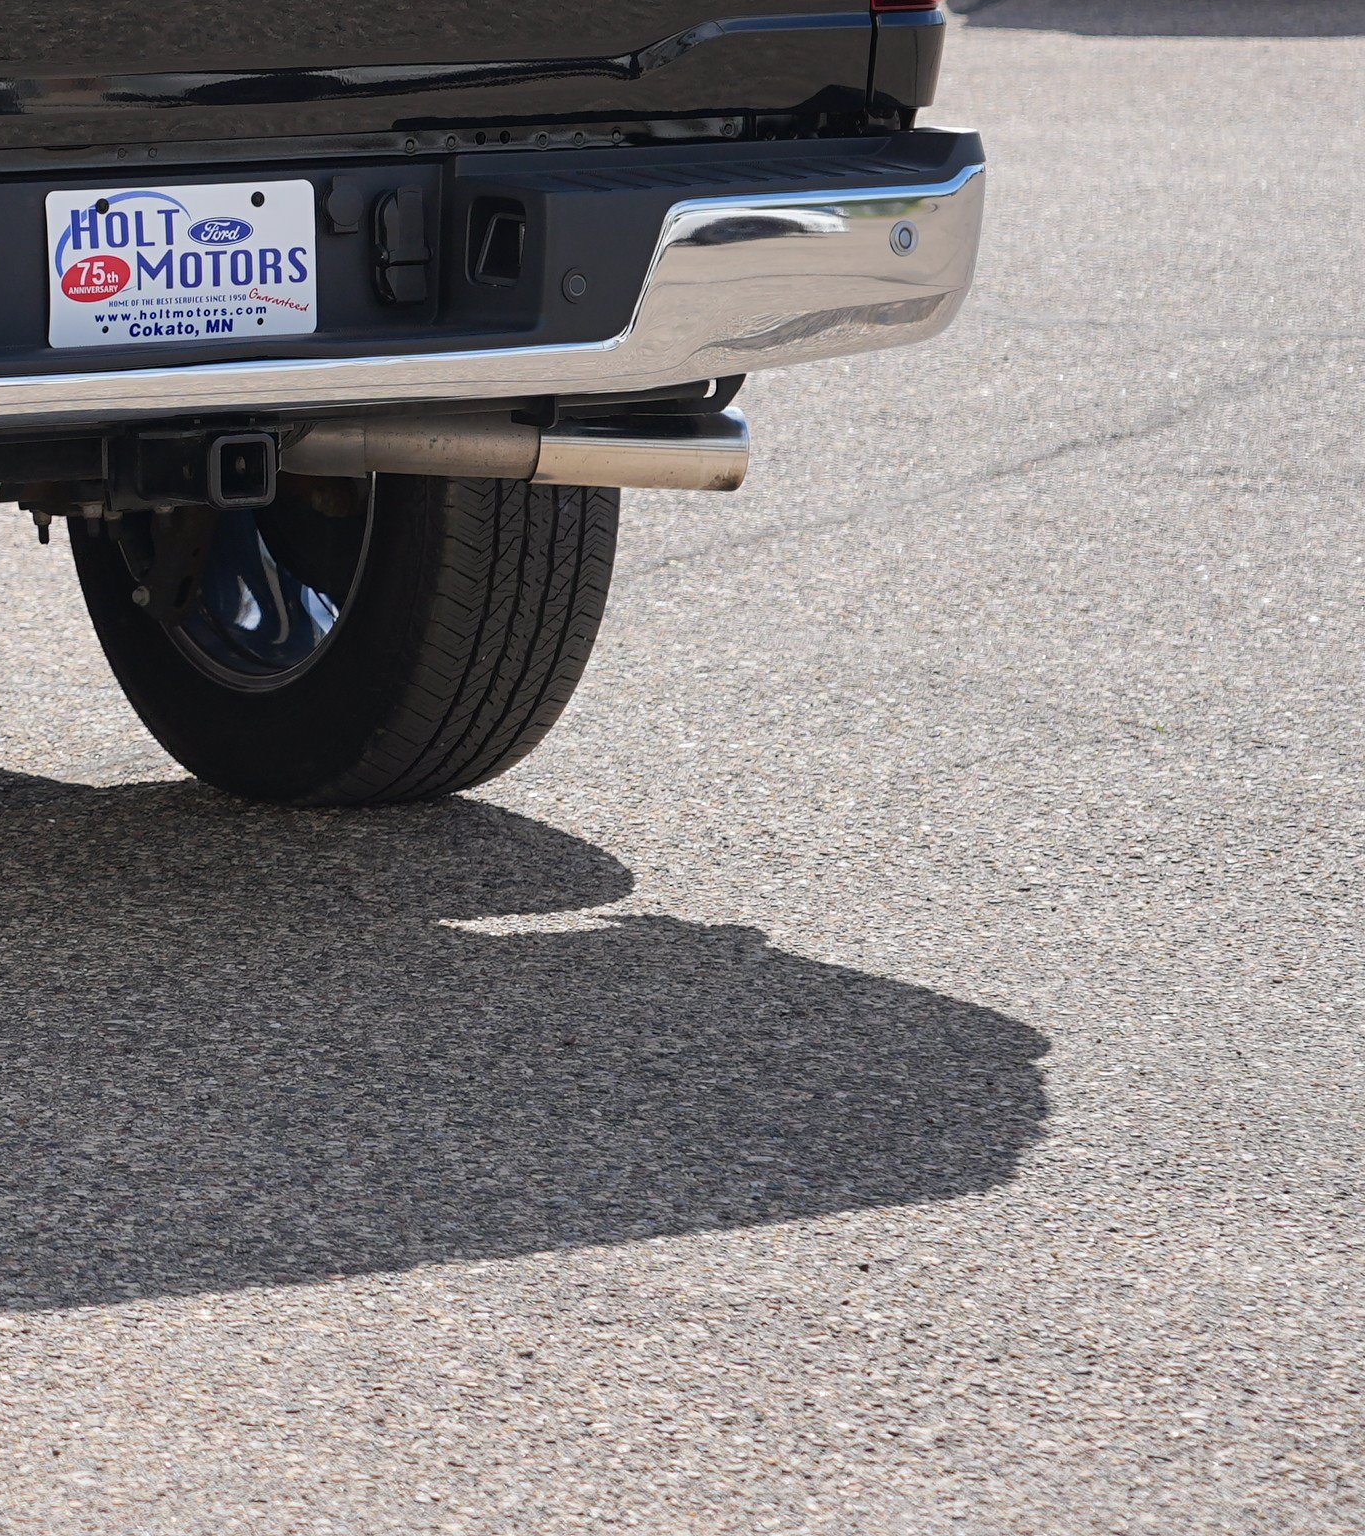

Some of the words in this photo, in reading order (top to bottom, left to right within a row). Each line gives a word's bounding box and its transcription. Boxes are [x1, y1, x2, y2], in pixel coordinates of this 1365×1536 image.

[71, 208, 180, 250] HOLT
[200, 221, 241, 242] Ford
[76, 261, 119, 286] 75th
[136, 247, 308, 291] MOTORS
[68, 284, 119, 295] ANNIVERSARY
[108, 299, 129, 307] HOME
[141, 298, 154, 306] THE
[156, 297, 174, 305] BEST
[175, 295, 203, 304] SERVICE
[206, 294, 227, 303] SINCE
[229, 293, 247, 302] 1950
[249, 287, 309, 312] Guaranteed
[95, 306, 267, 323] www.holtmotors.com
[129, 322, 200, 338] Cokato,
[205, 318, 235, 334] MN
